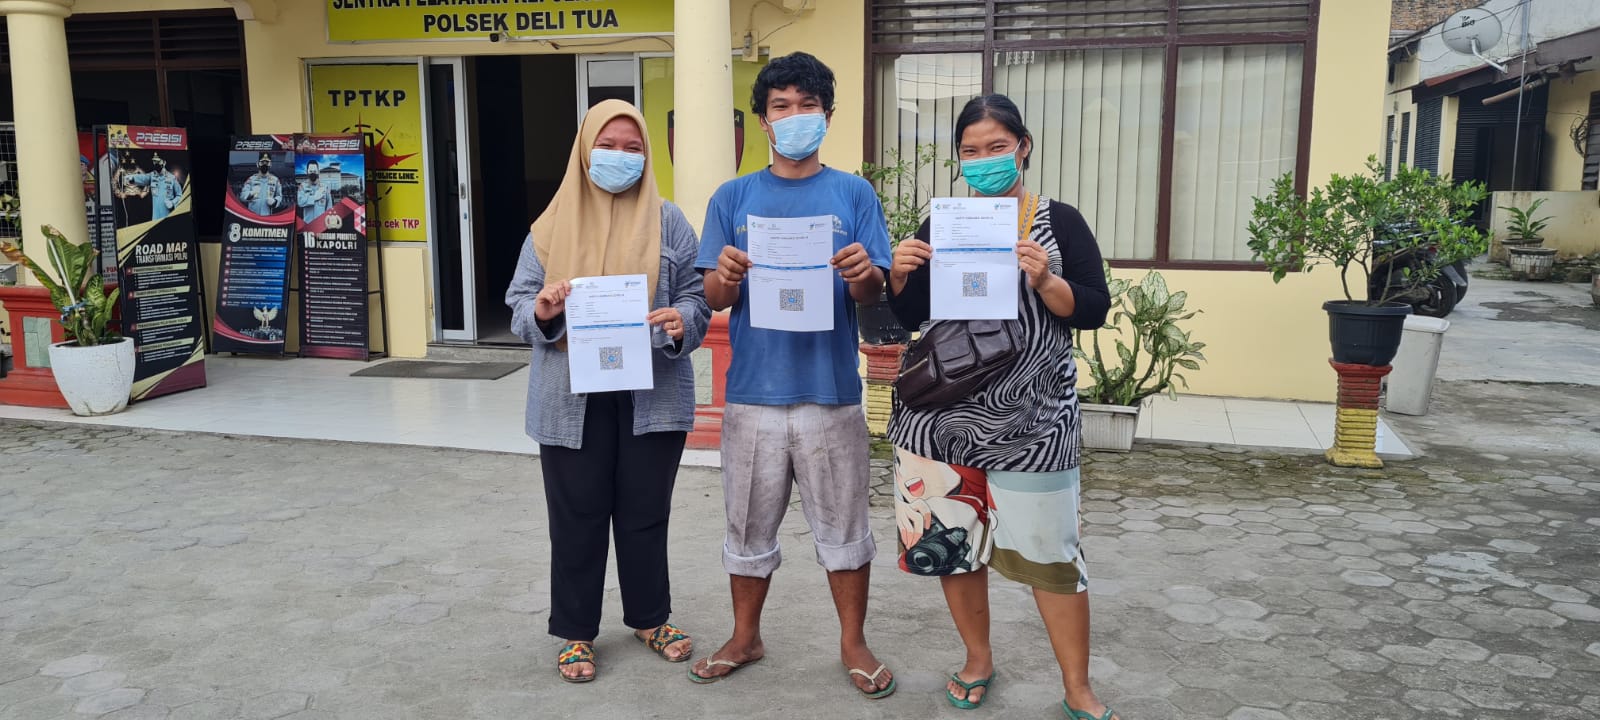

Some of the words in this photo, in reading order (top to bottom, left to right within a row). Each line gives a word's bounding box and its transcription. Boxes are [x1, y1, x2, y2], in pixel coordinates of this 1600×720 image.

[423, 13, 509, 32] POLSEK
[516, 11, 564, 30] DELI
[572, 9, 619, 29] TUA
[328, 89, 406, 107] TPTKP
[136, 132, 182, 143] PRESISI
[317, 139, 360, 148] PRESISI
[384, 219, 400, 229] cek
[402, 218, 420, 229] TKP
[229, 222, 241, 243] 8
[242, 227, 289, 238] KOMITMEN
[303, 231, 316, 249] 16
[316, 240, 358, 250] KAPOLRI
[135, 243, 164, 256] ROAD
[166, 241, 188, 254] MAP
